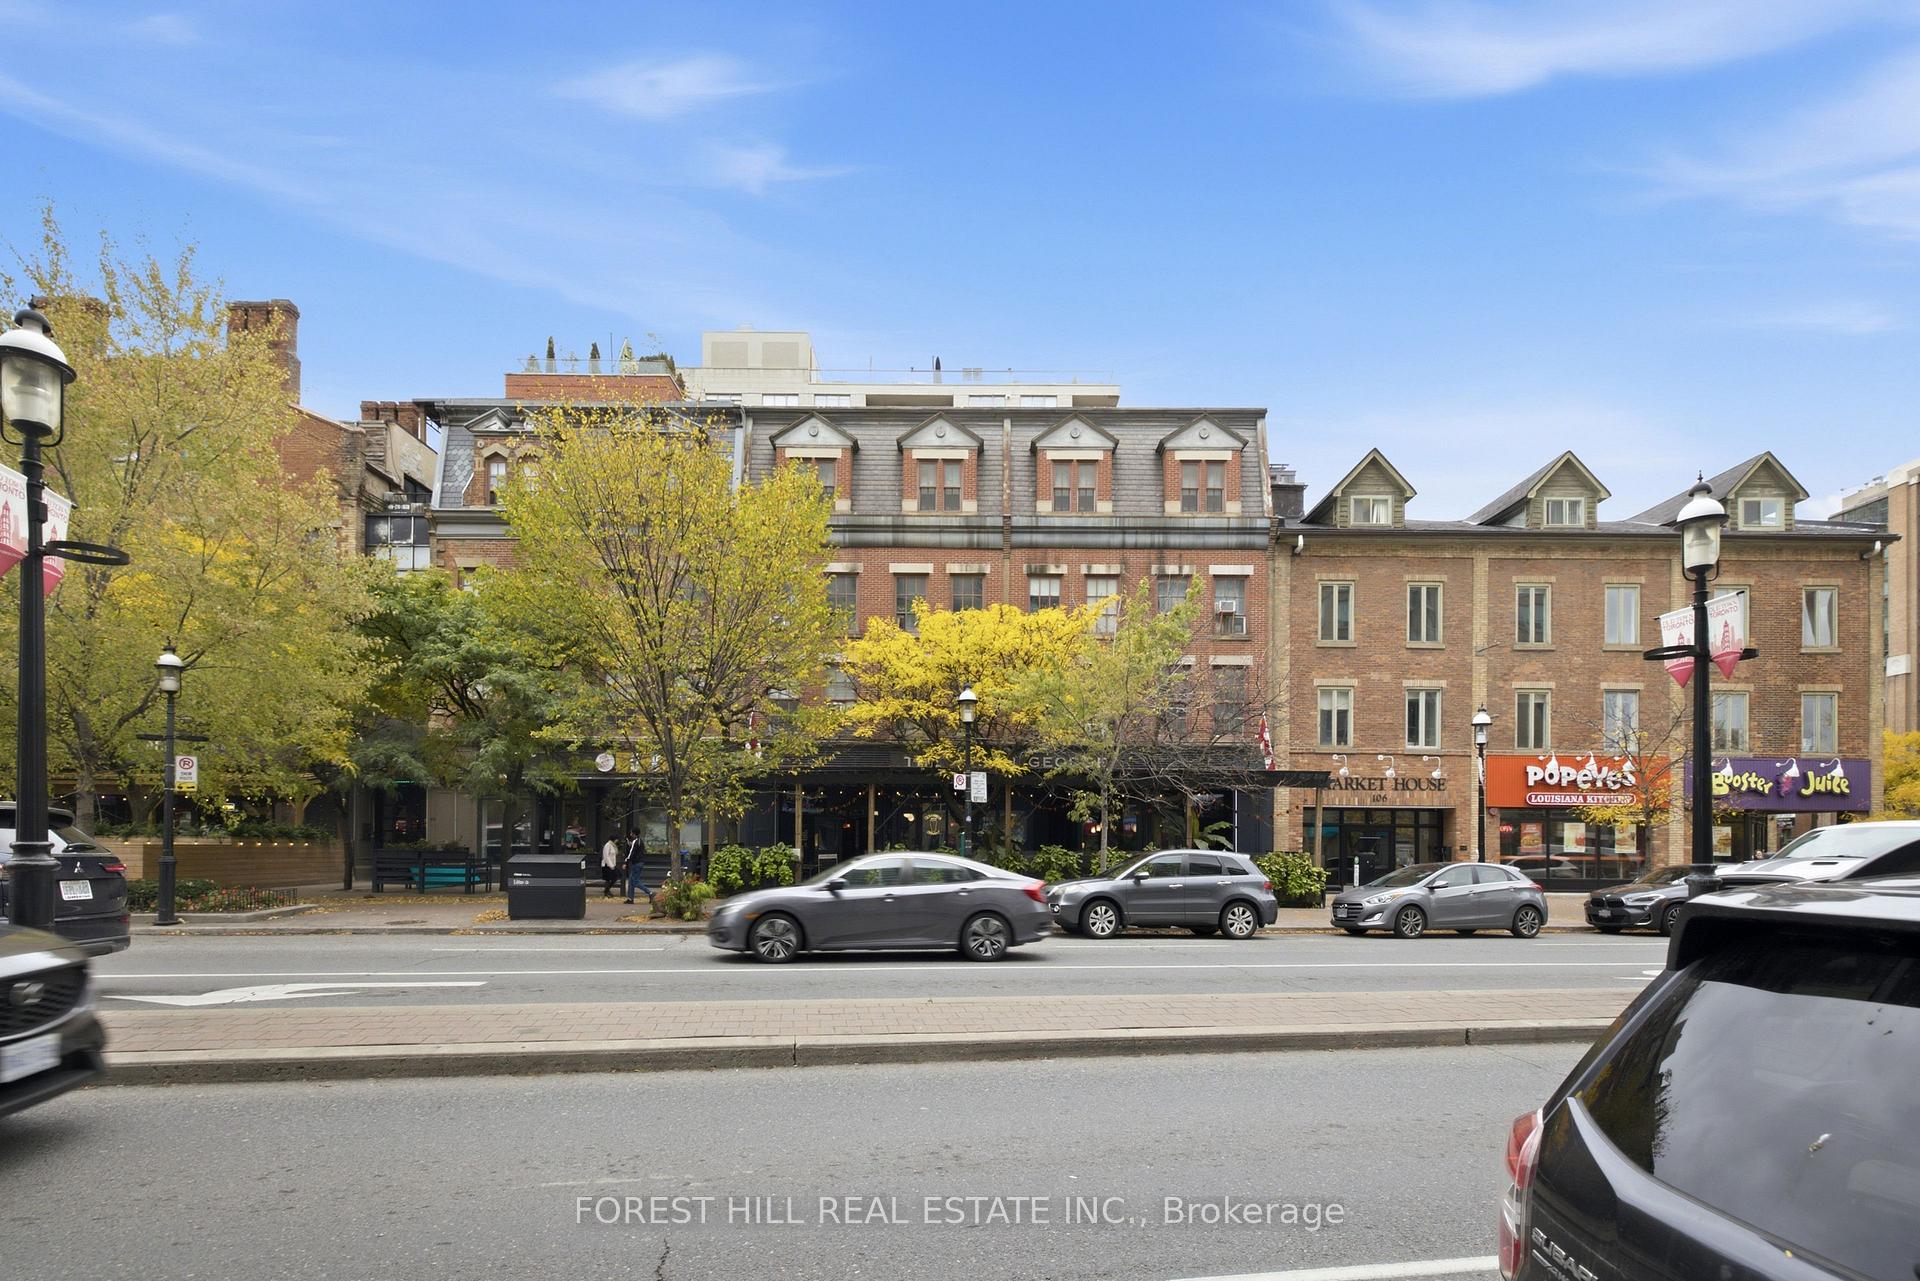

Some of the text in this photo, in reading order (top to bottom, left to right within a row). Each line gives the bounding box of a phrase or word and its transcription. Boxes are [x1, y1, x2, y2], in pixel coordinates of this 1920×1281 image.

[1327, 777, 1447, 791] ARKET HOUSE
[1800, 771, 1850, 794] Juice
[1531, 794, 1584, 803] LOUISIANA
[1531, 1226, 1599, 1281] SUBAR
